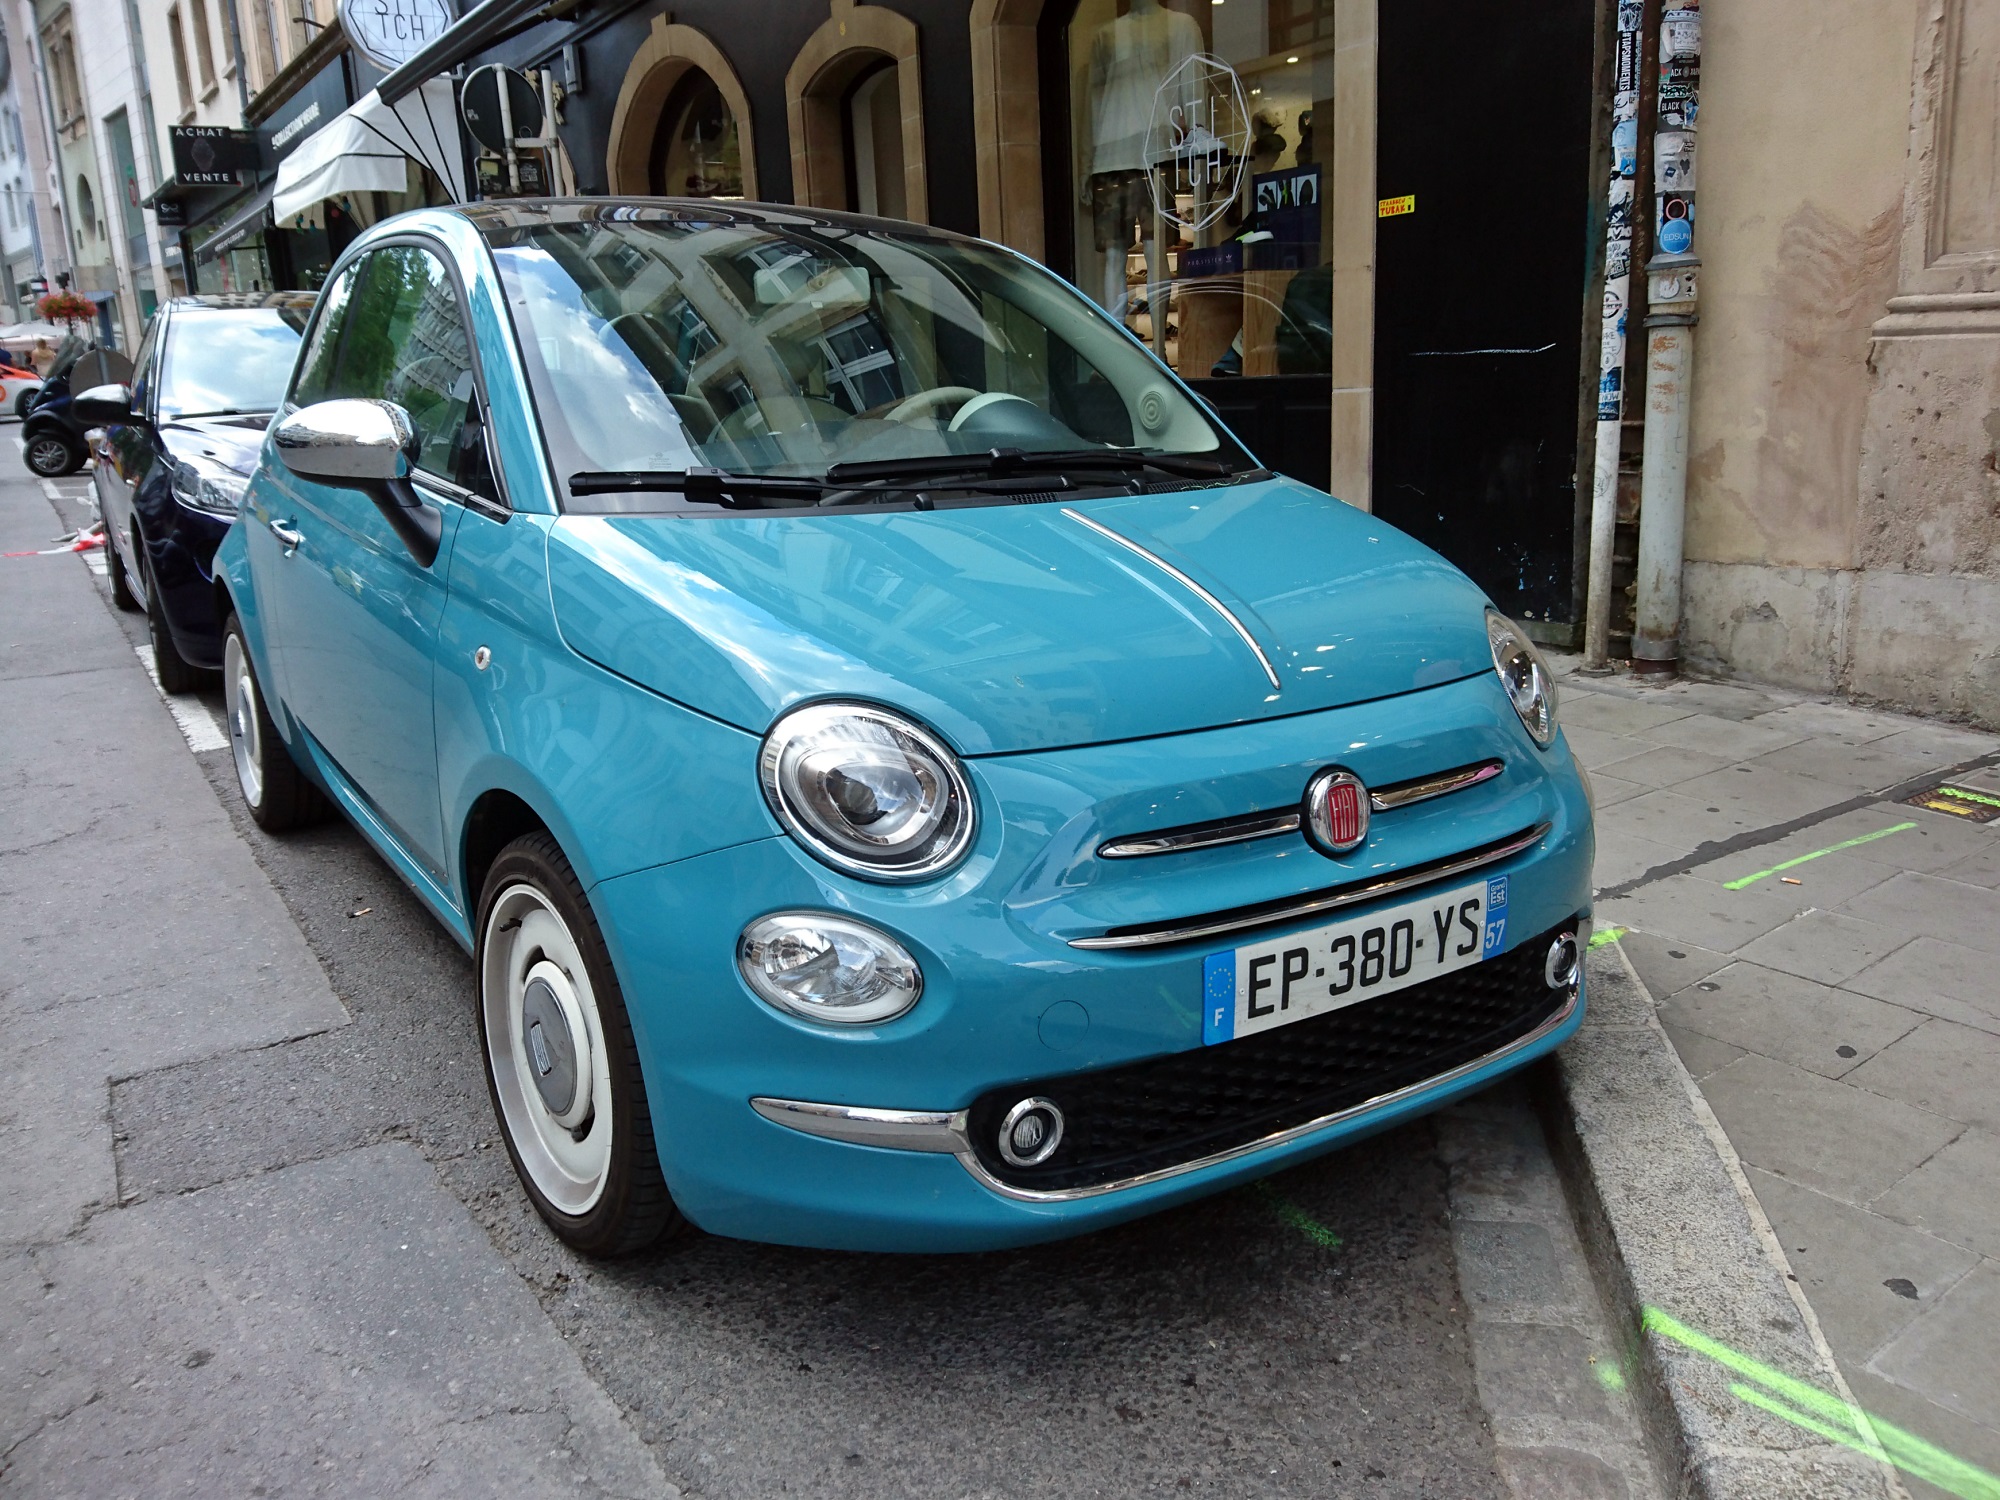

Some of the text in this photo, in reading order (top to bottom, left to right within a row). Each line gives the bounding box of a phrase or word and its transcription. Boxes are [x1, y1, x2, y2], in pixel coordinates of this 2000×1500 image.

[375, 13, 425, 41] TCH
[1661, 101, 1680, 111] BLACK
[175, 127, 224, 137] ACHAT
[1168, 95, 1217, 149] STI
[1169, 137, 1222, 191] TCH
[183, 173, 229, 182] VENTE
[1380, 204, 1406, 216] TUBAK
[1663, 232, 1690, 241] EDSUN
[1330, 787, 1355, 840] FIAT
[1490, 889, 1506, 904] Est
[1485, 918, 1506, 949] 57
[1247, 898, 1480, 1020] EP-380-YS
[1214, 1007, 1225, 1027] F
